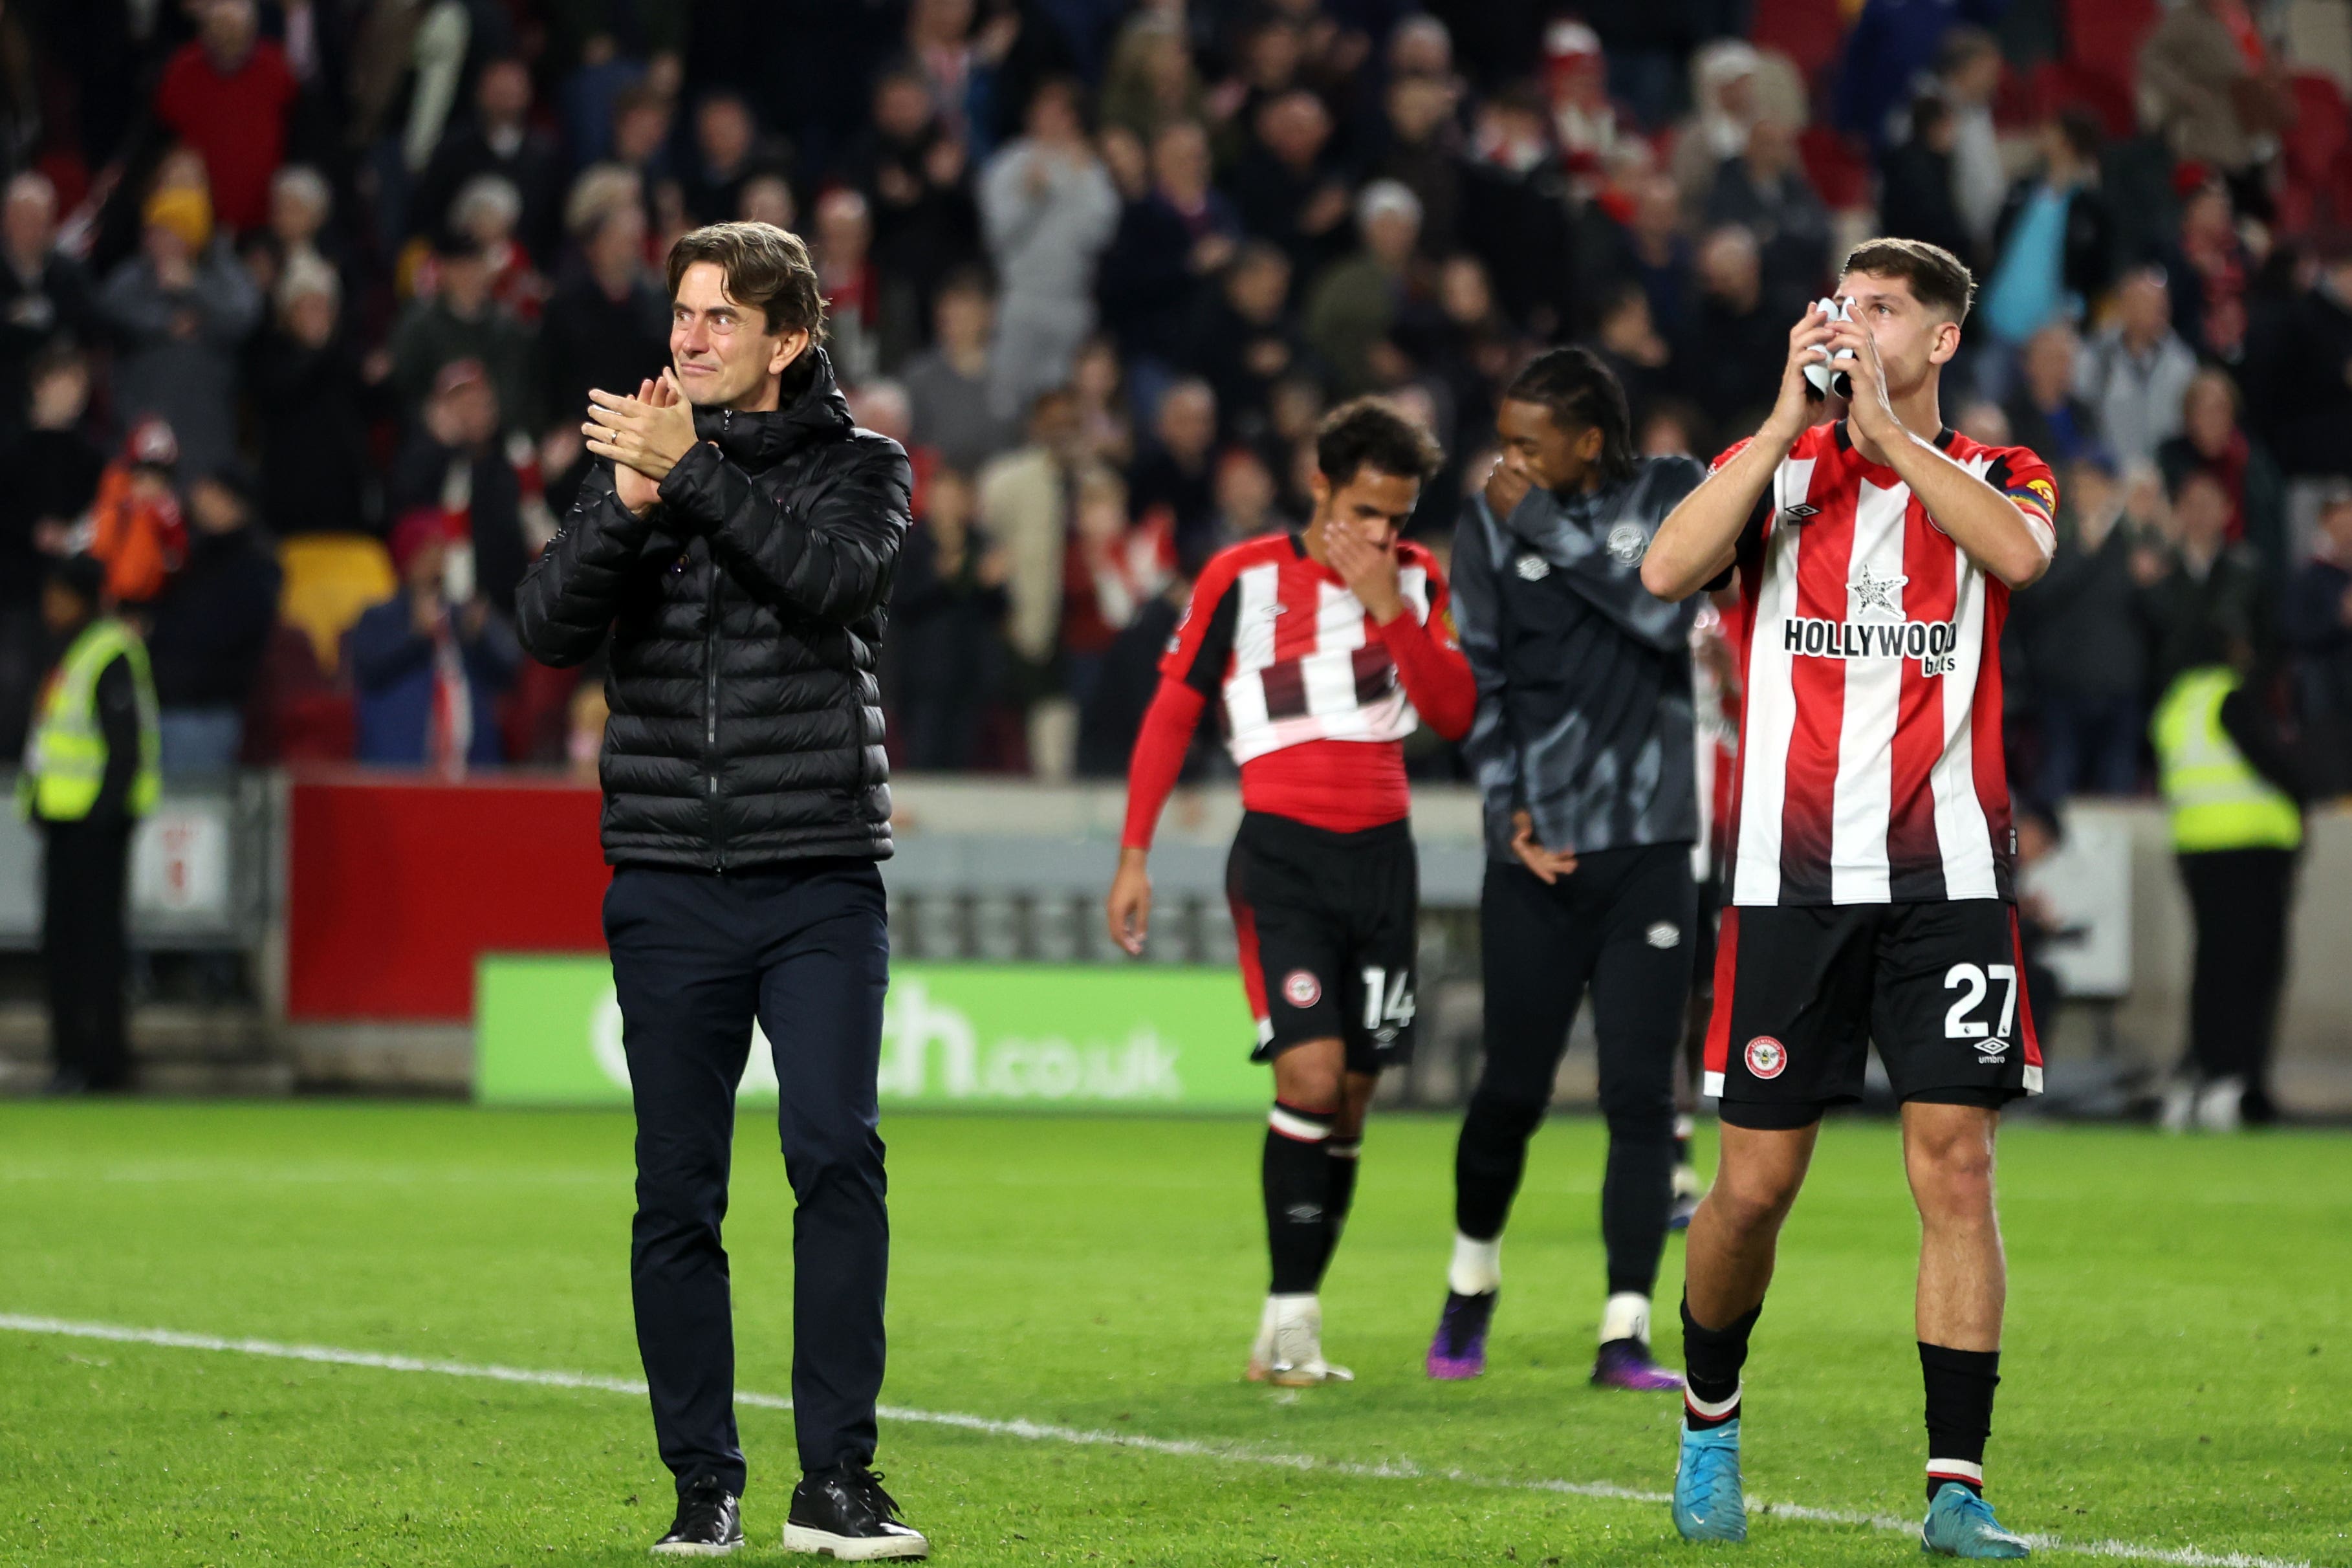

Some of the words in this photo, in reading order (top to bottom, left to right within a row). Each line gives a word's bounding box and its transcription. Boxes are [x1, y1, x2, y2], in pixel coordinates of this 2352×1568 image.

[1784, 618, 1957, 657] HOLLYWOOD
[1361, 965, 1416, 1030] 14
[1944, 962, 2018, 1039] 27
[1977, 1054, 2006, 1064] umbro
